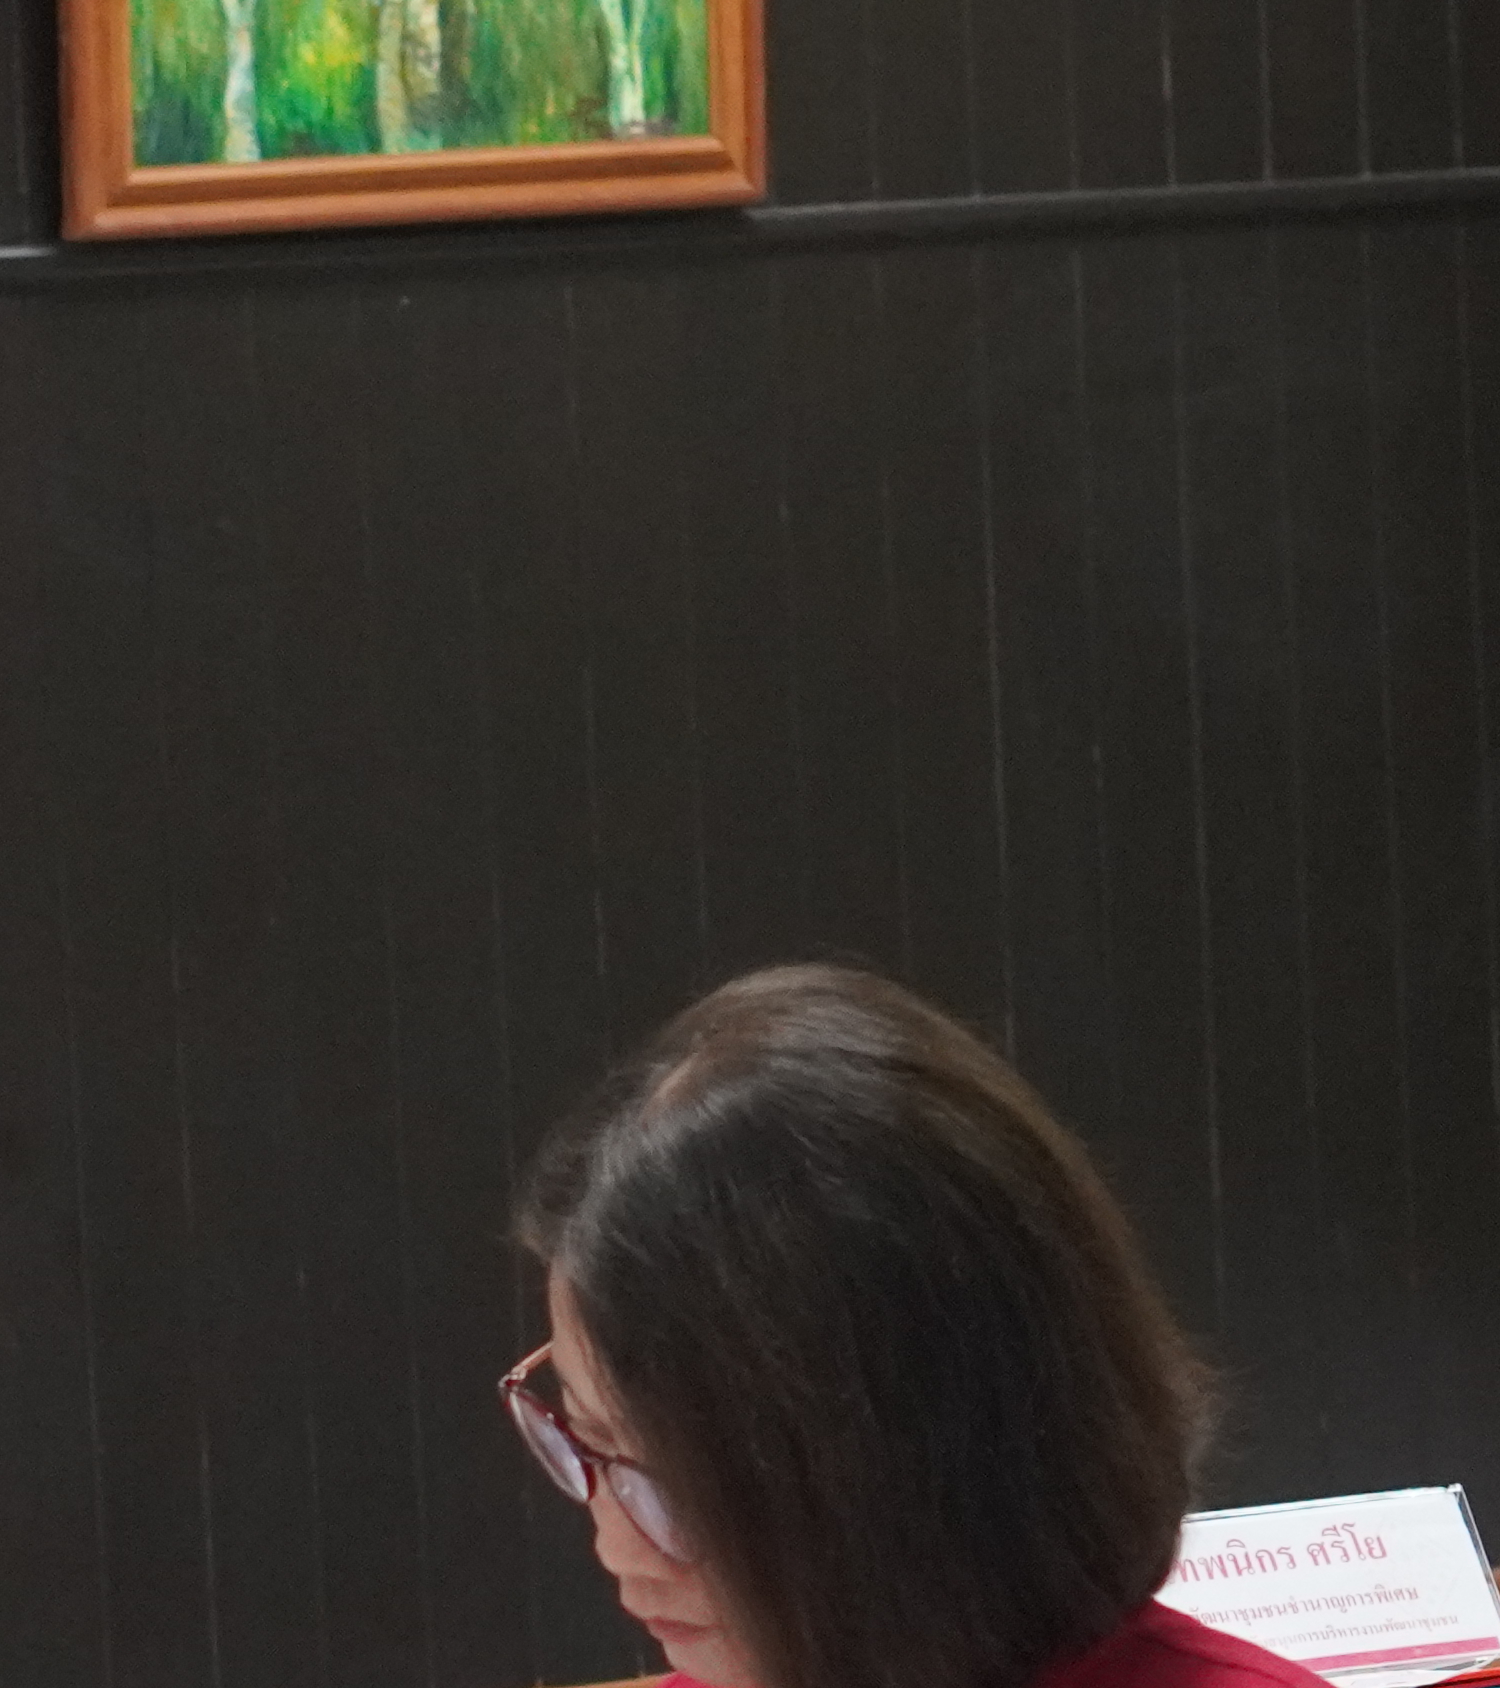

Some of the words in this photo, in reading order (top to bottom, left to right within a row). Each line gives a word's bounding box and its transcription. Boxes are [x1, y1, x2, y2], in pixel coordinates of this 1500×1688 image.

[1168, 1538, 1297, 1584] ทพนิกร
[1306, 1522, 1388, 1567] ศรีโย
[1189, 1583, 1420, 1627] ัฒนาชุมชนชำนาญการพิเศษ
